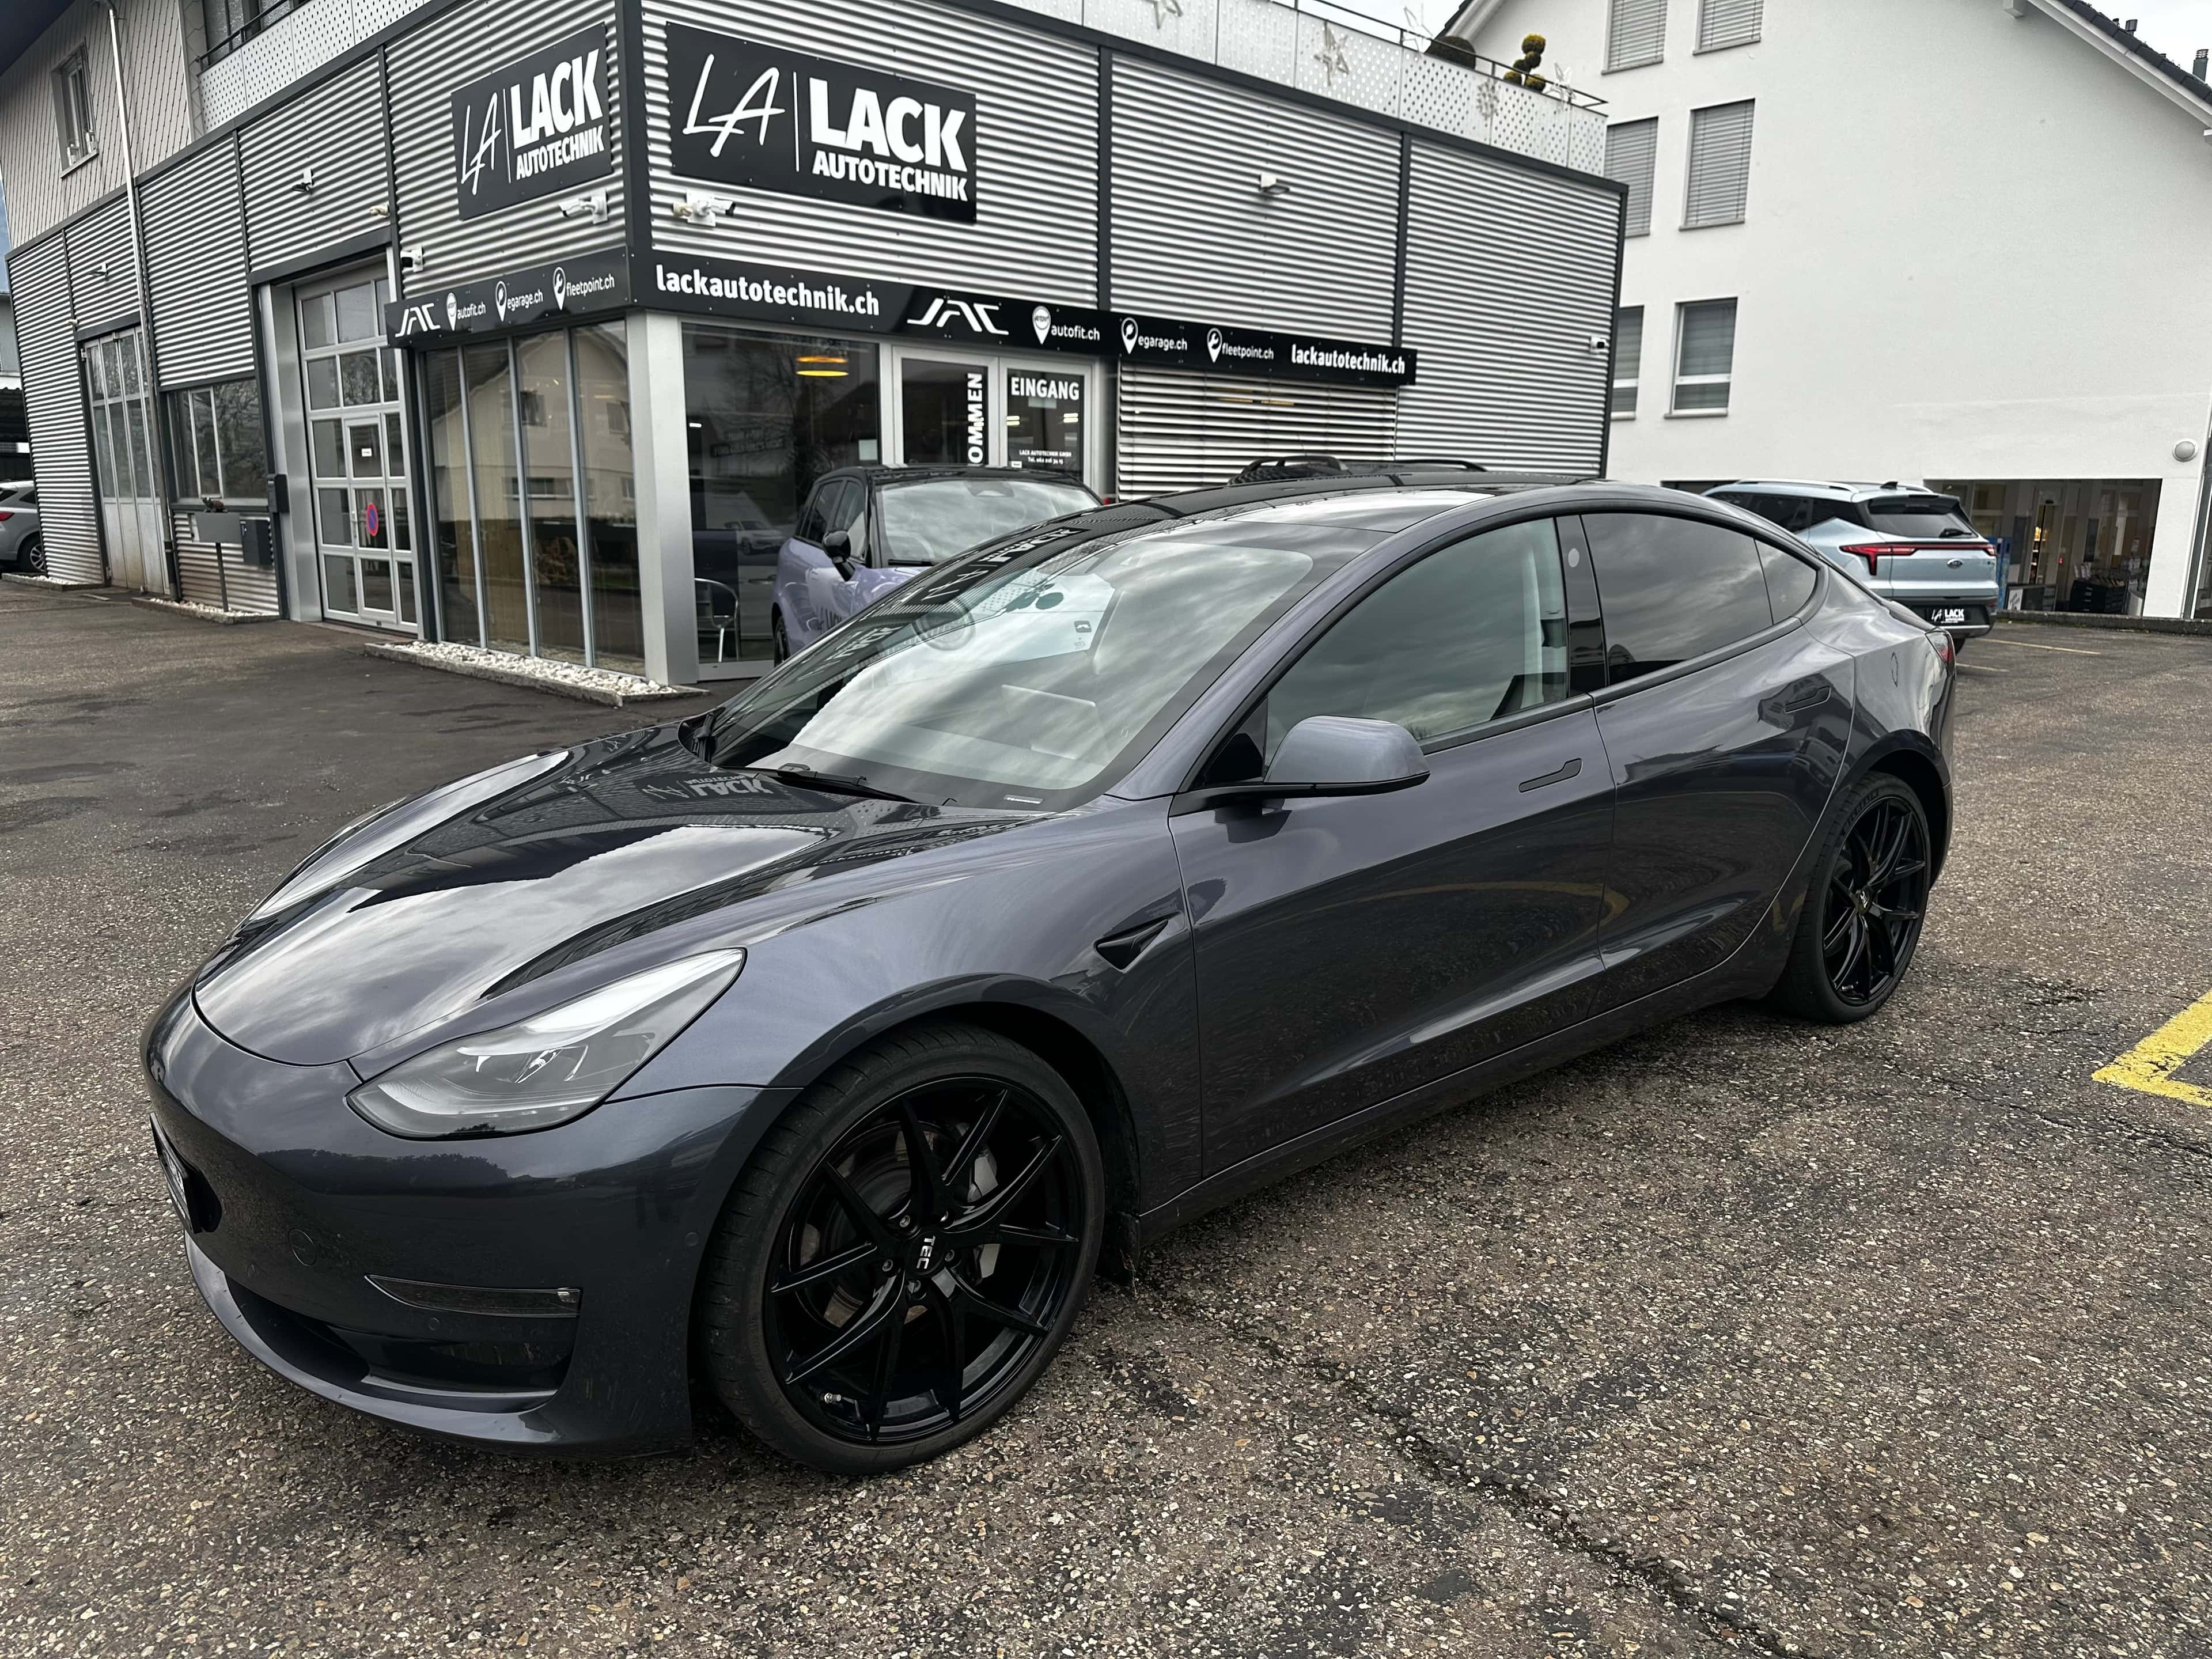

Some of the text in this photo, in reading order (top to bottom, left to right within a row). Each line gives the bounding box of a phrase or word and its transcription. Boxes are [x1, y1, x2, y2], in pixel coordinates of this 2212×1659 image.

[510, 49, 603, 149] LACK
[809, 77, 967, 172] LACK
[517, 125, 604, 180] AUTOTECHNIK
[813, 150, 968, 201] AUTOTECHNIK
[566, 274, 615, 297] fleetpoint.ch
[656, 264, 880, 316] lackautotechnik.ch
[456, 303, 486, 320] autofit.ch
[506, 289, 543, 311] egarage.ch
[1051, 325, 1100, 340] autofit.ch
[1138, 335, 1188, 351] egarage.ch
[1221, 342, 1274, 360] fleetpoint.ch
[1291, 344, 1406, 374] lackautotechnik.ch
[1011, 377, 1080, 400] EINGANG
[1945, 608, 1964, 618] LACK
[916, 1235, 936, 1269] TEC
